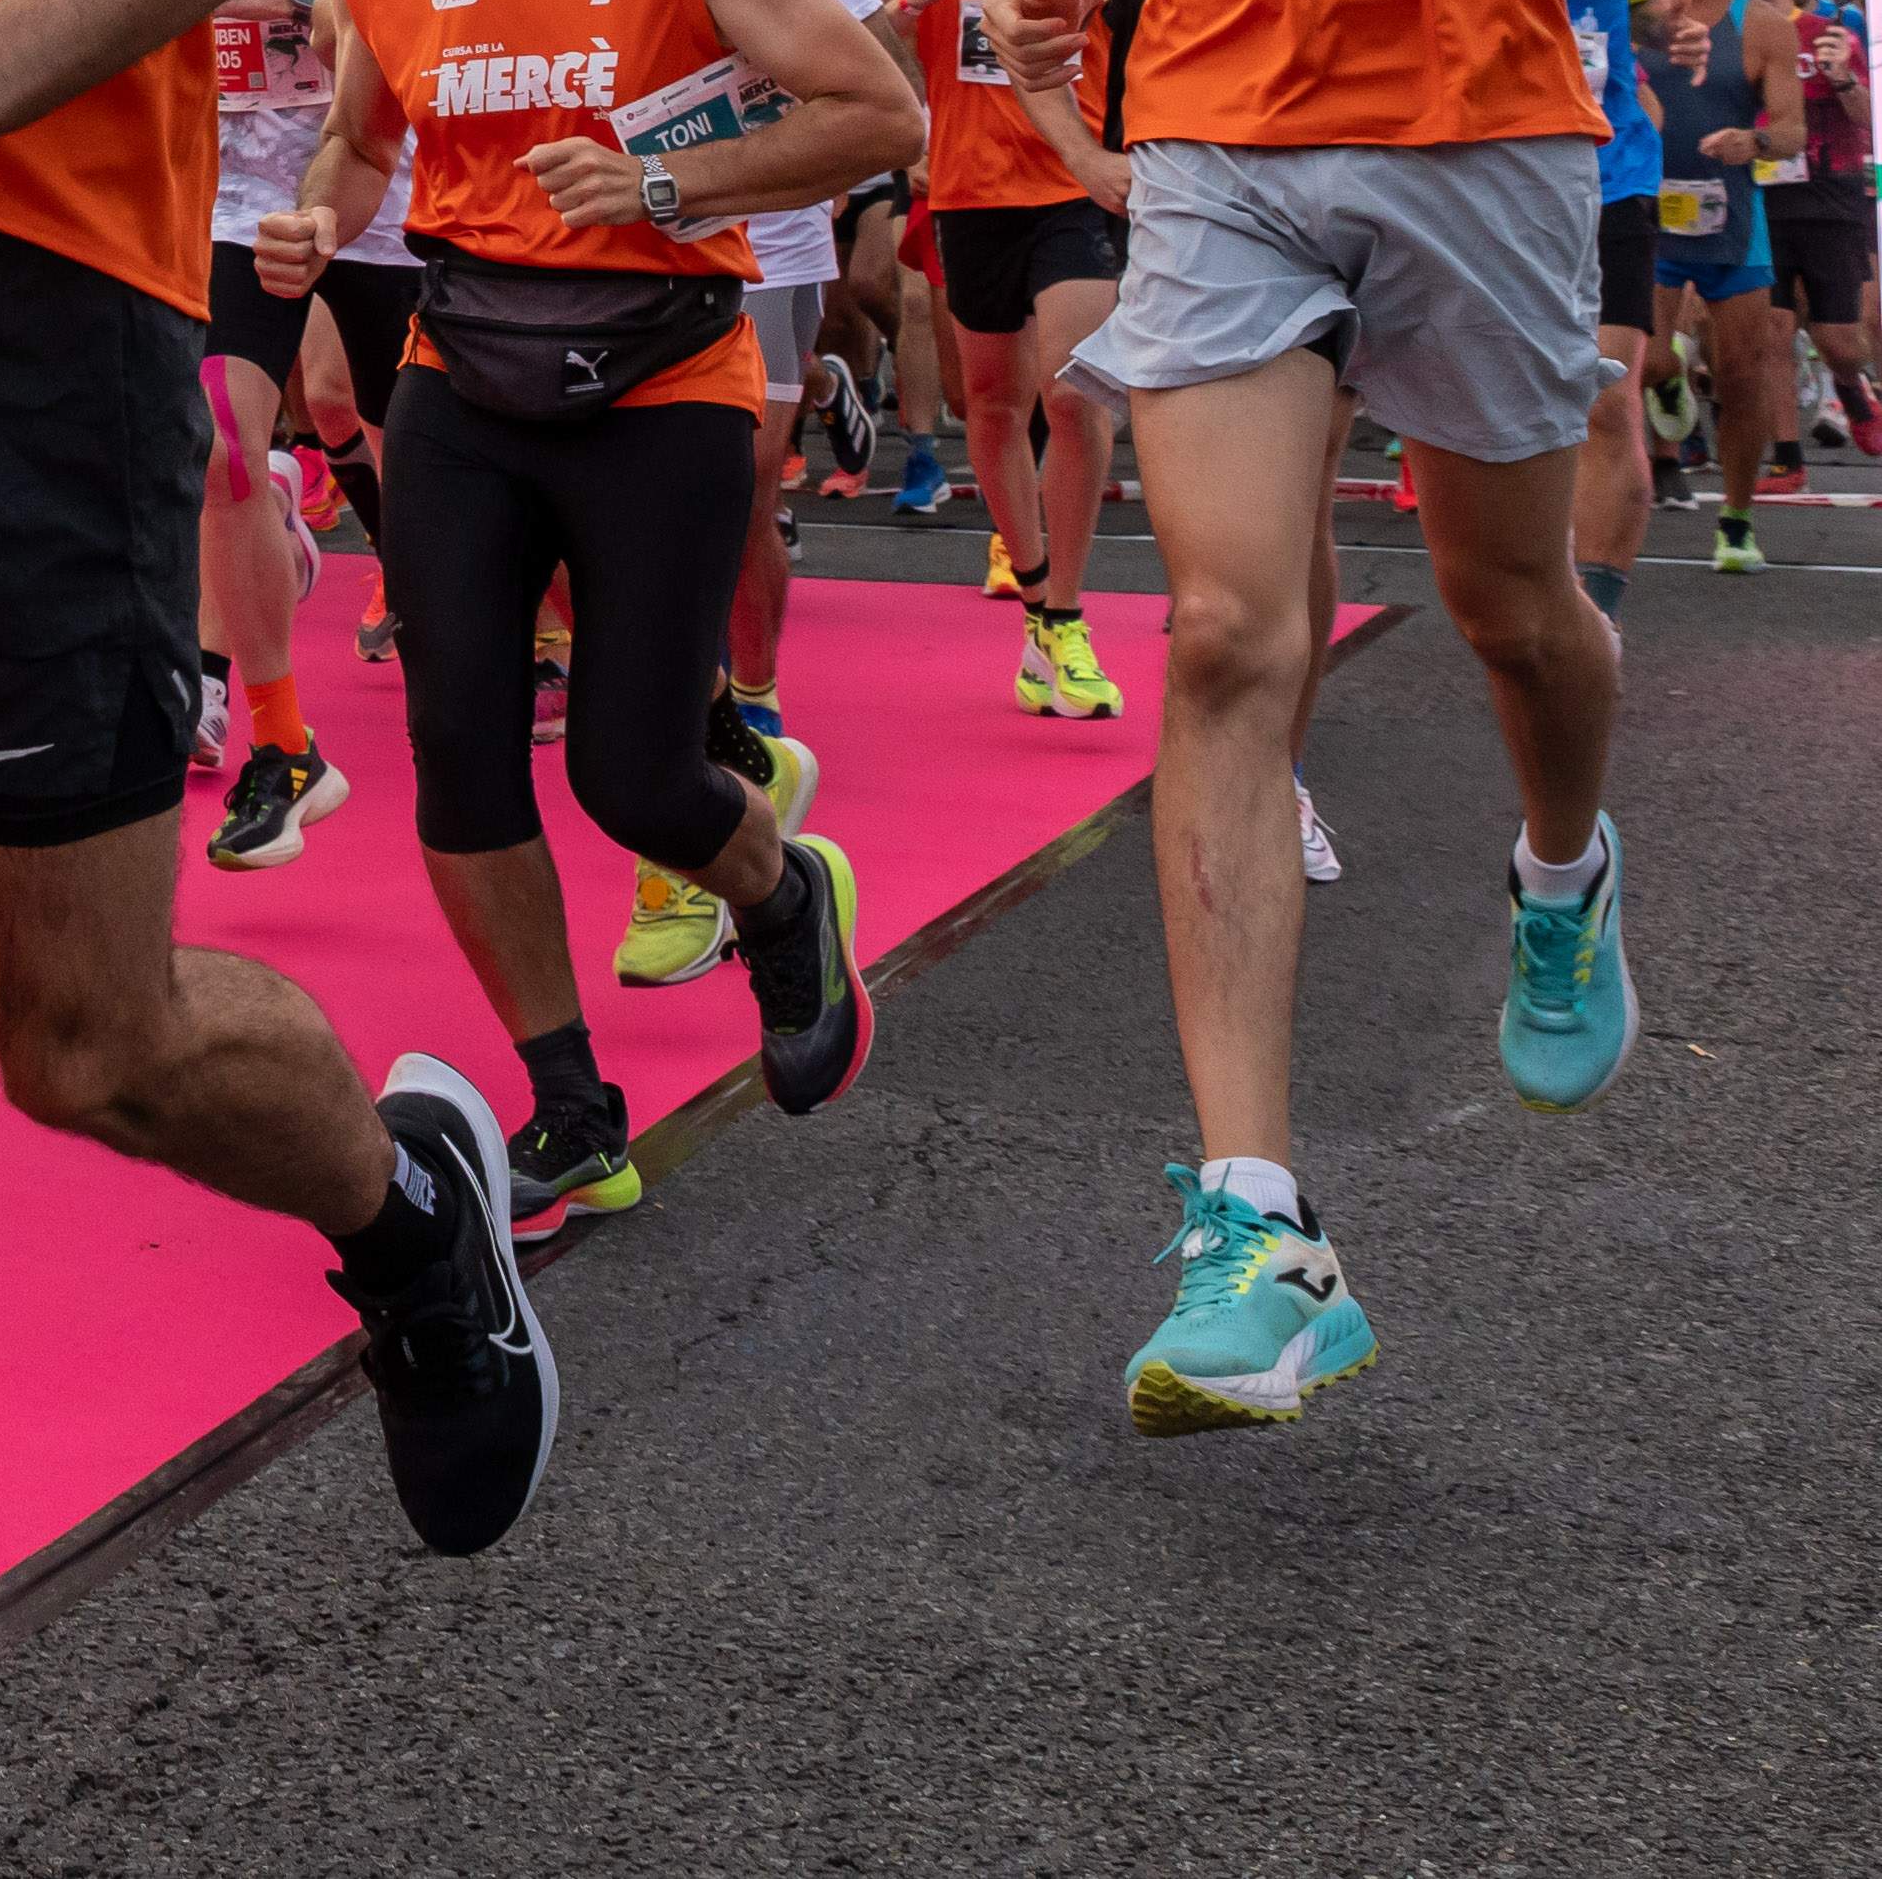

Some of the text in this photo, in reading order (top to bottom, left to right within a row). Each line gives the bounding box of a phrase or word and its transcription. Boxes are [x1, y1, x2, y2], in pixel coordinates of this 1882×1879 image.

[442, 42, 505, 58] CURSA DE LA
[425, 37, 619, 118] MERCÈ
[655, 111, 714, 152] TONI
